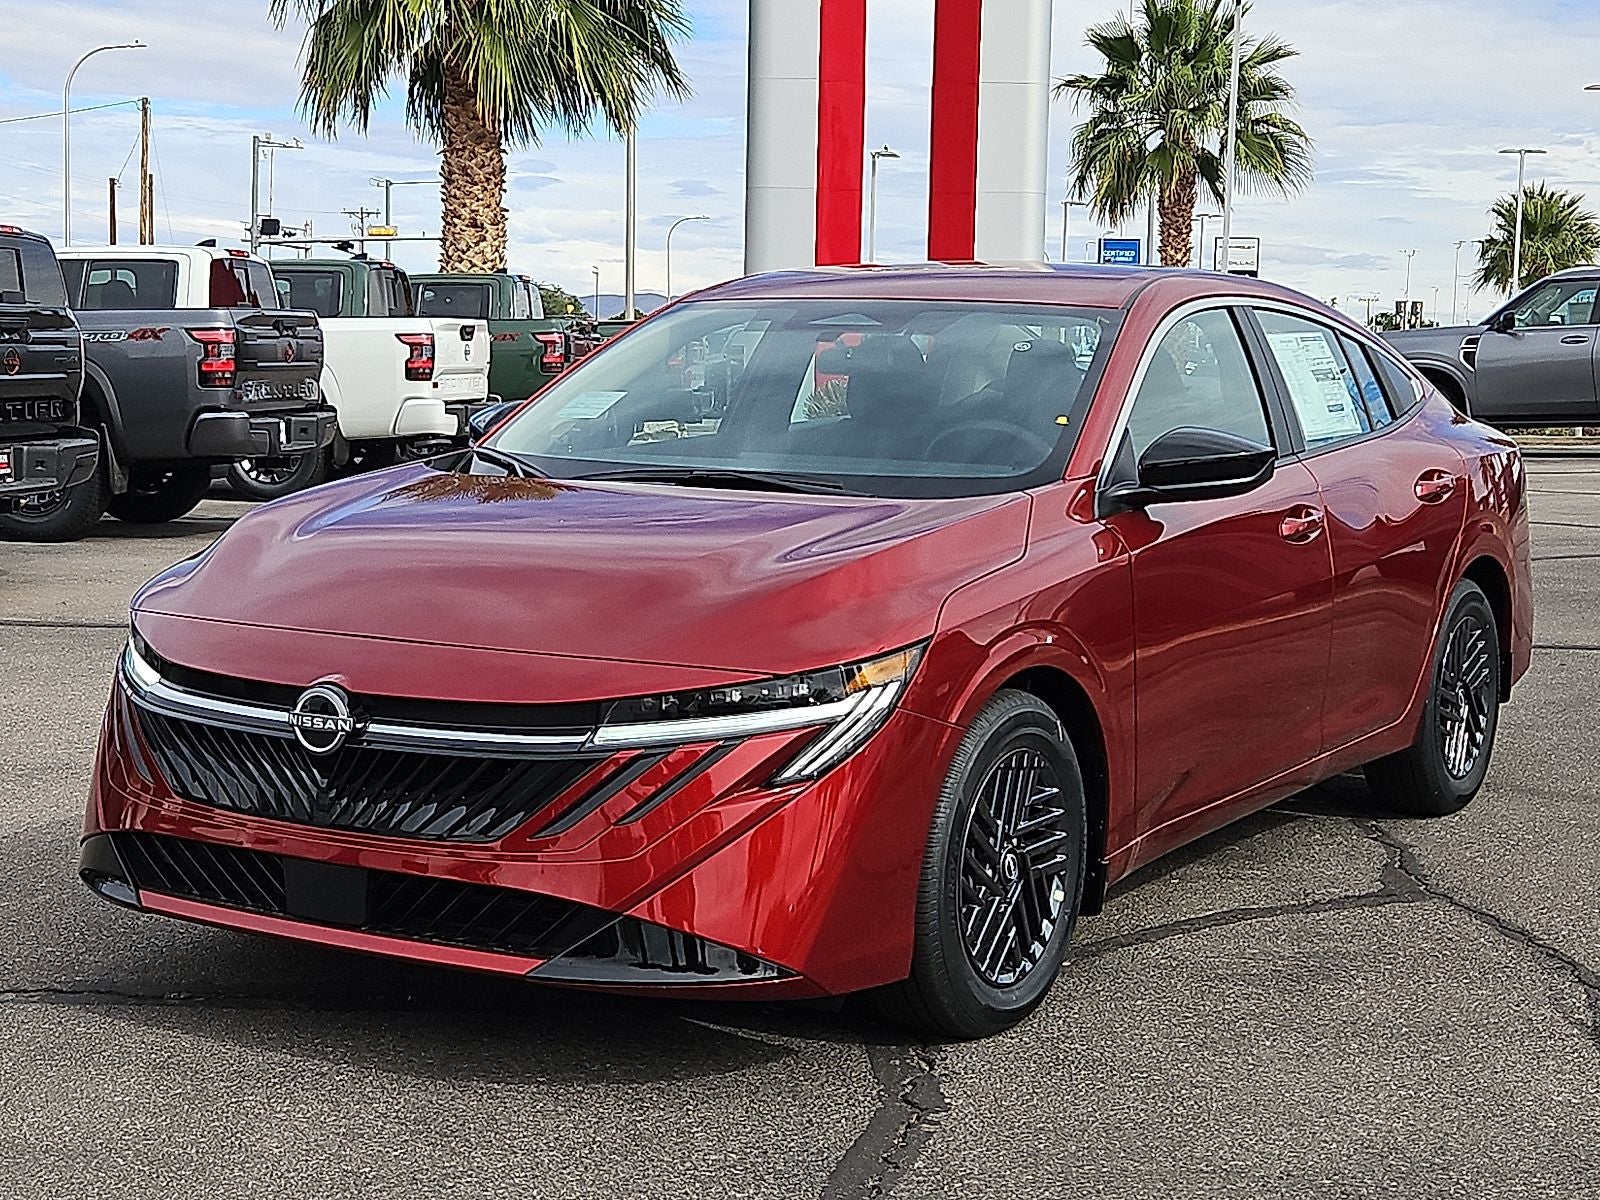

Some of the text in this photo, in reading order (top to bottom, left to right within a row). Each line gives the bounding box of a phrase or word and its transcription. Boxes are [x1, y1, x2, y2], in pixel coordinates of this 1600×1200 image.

[242, 379, 319, 400] FRONTIER
[0, 400, 65, 420] TIER
[289, 714, 350, 732] NISSAN
